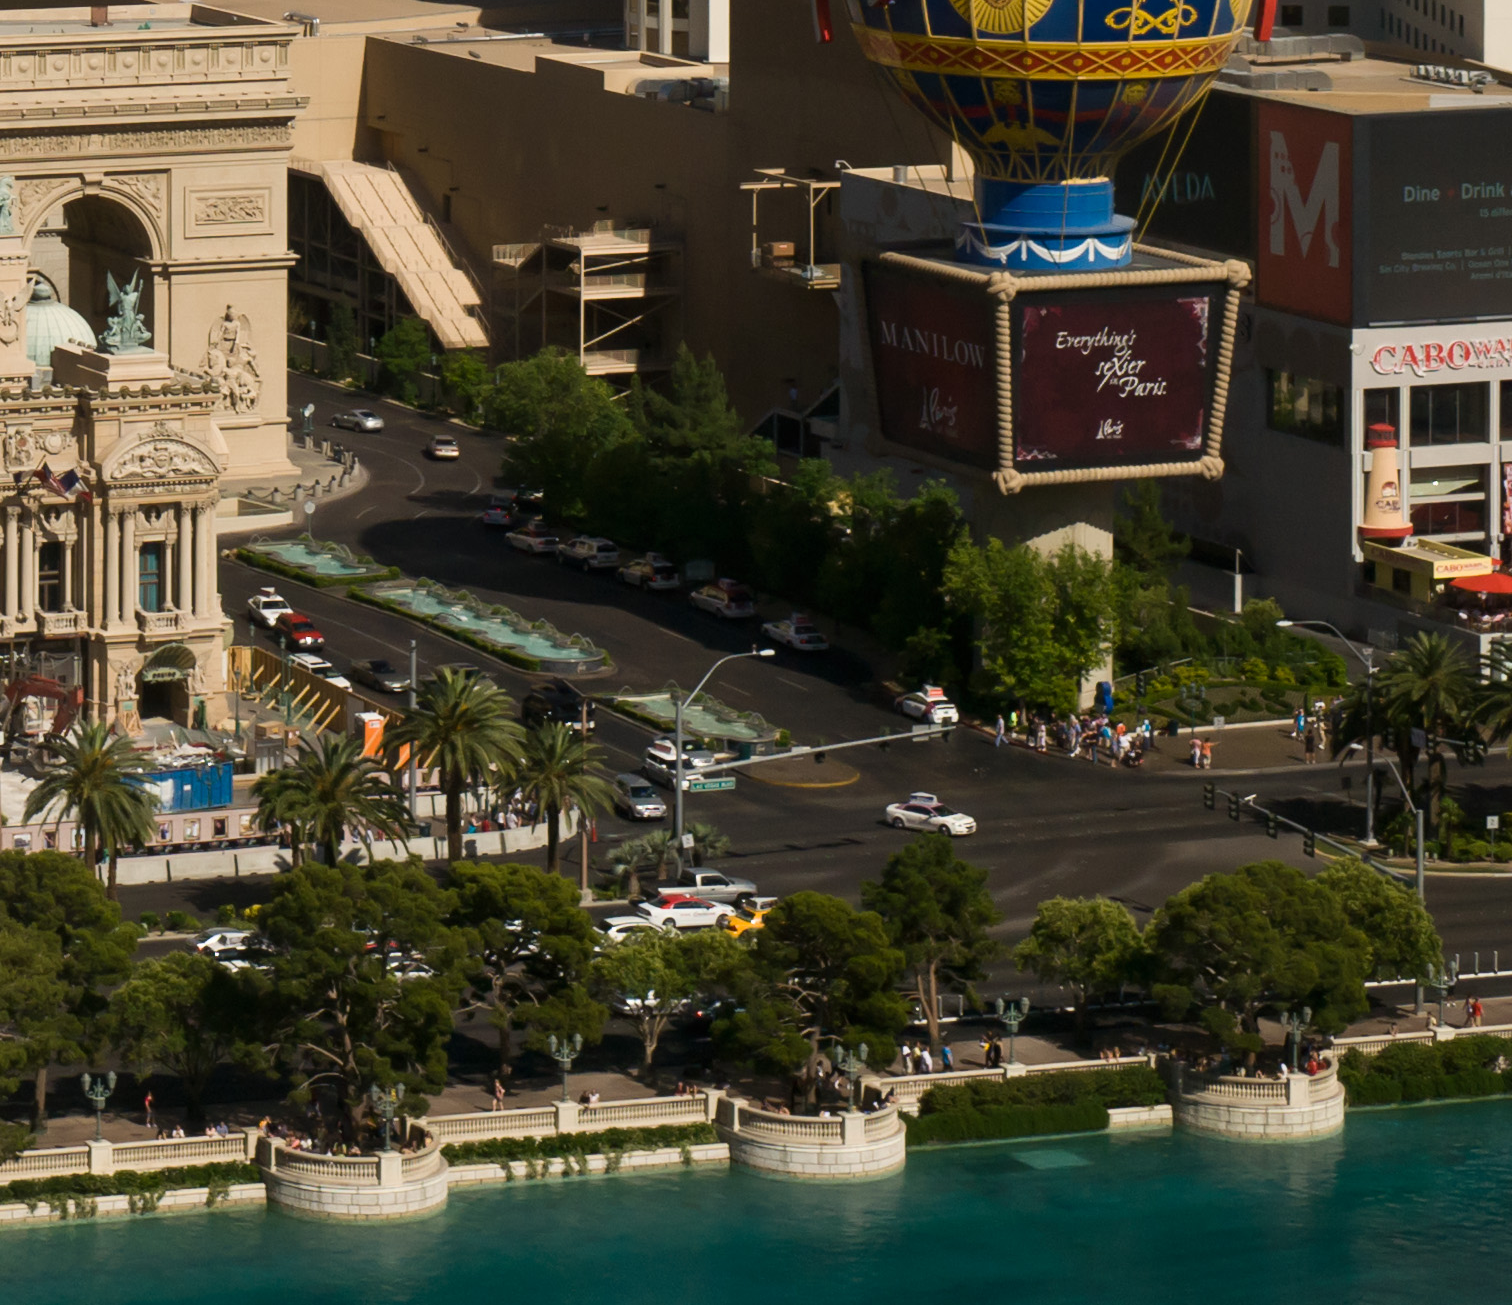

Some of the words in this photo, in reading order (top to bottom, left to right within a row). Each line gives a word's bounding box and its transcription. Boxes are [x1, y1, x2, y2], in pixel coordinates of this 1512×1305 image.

[1402, 185, 1441, 202] Dine
[1461, 182, 1506, 199] Drink
[881, 320, 985, 368] MANILOW
[1055, 327, 1136, 356] Everything's
[1372, 340, 1472, 374] CABO
[1119, 377, 1167, 398] Paris.
[1436, 563, 1463, 573] CABO
